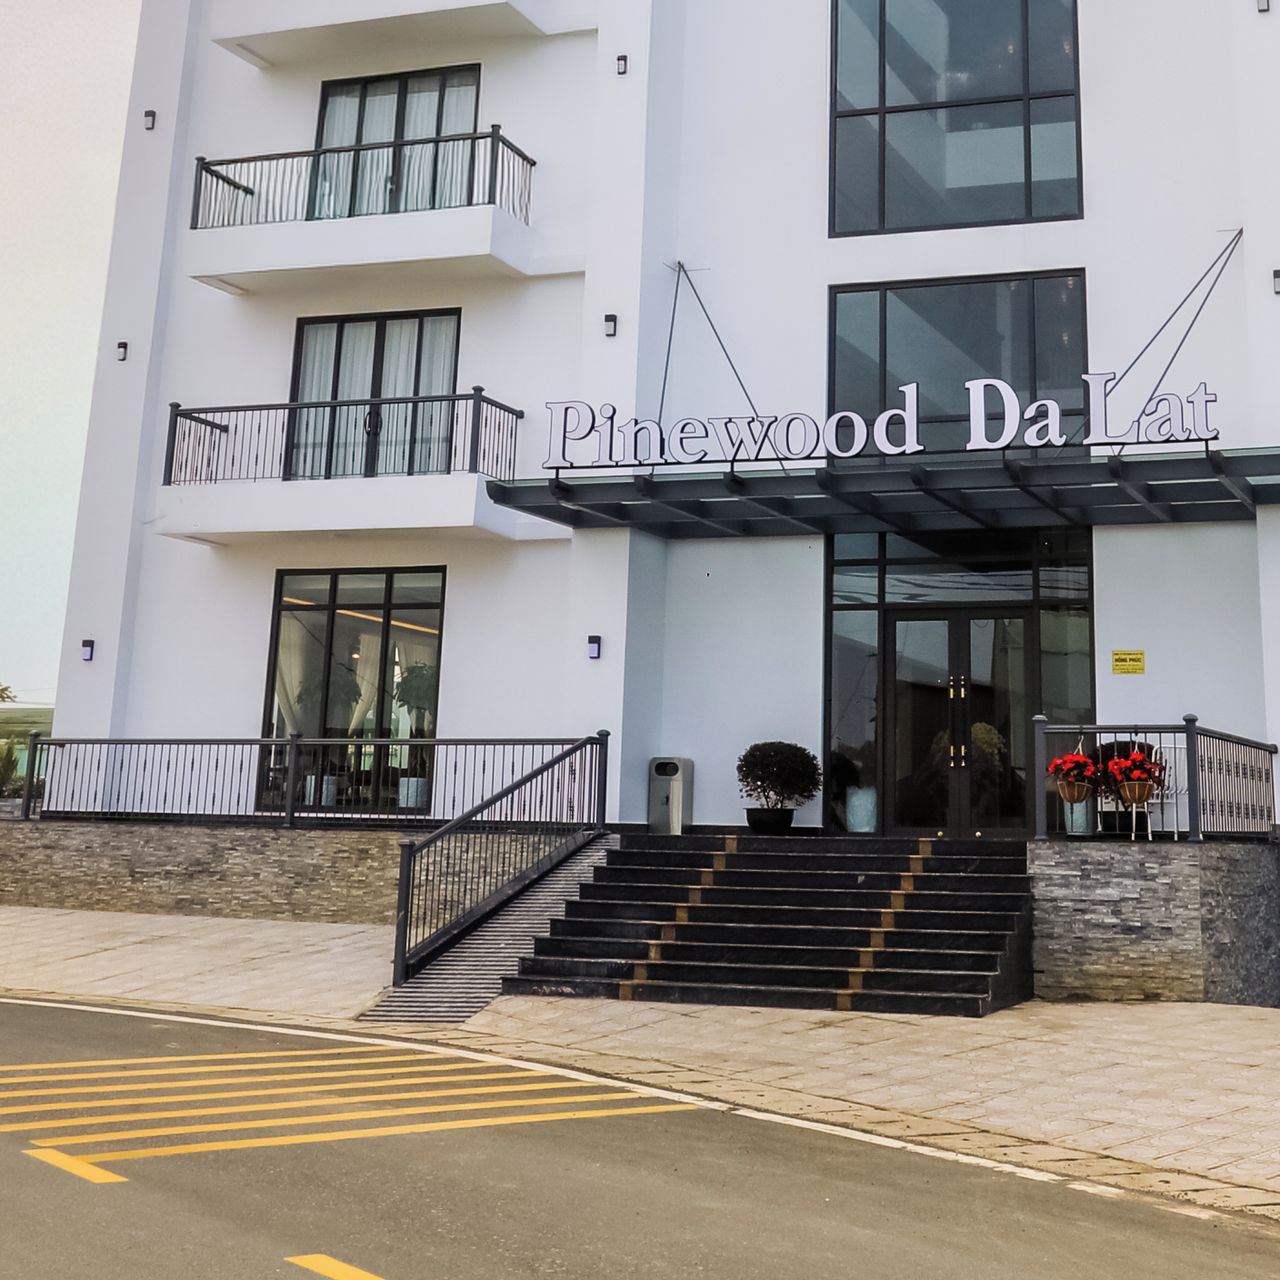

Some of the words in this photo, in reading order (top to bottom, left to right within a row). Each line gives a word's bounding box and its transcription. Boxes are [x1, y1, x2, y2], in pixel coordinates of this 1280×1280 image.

[541, 381, 925, 469] Pinewood
[964, 378, 1068, 451] Da
[1081, 372, 1219, 445] Lat
